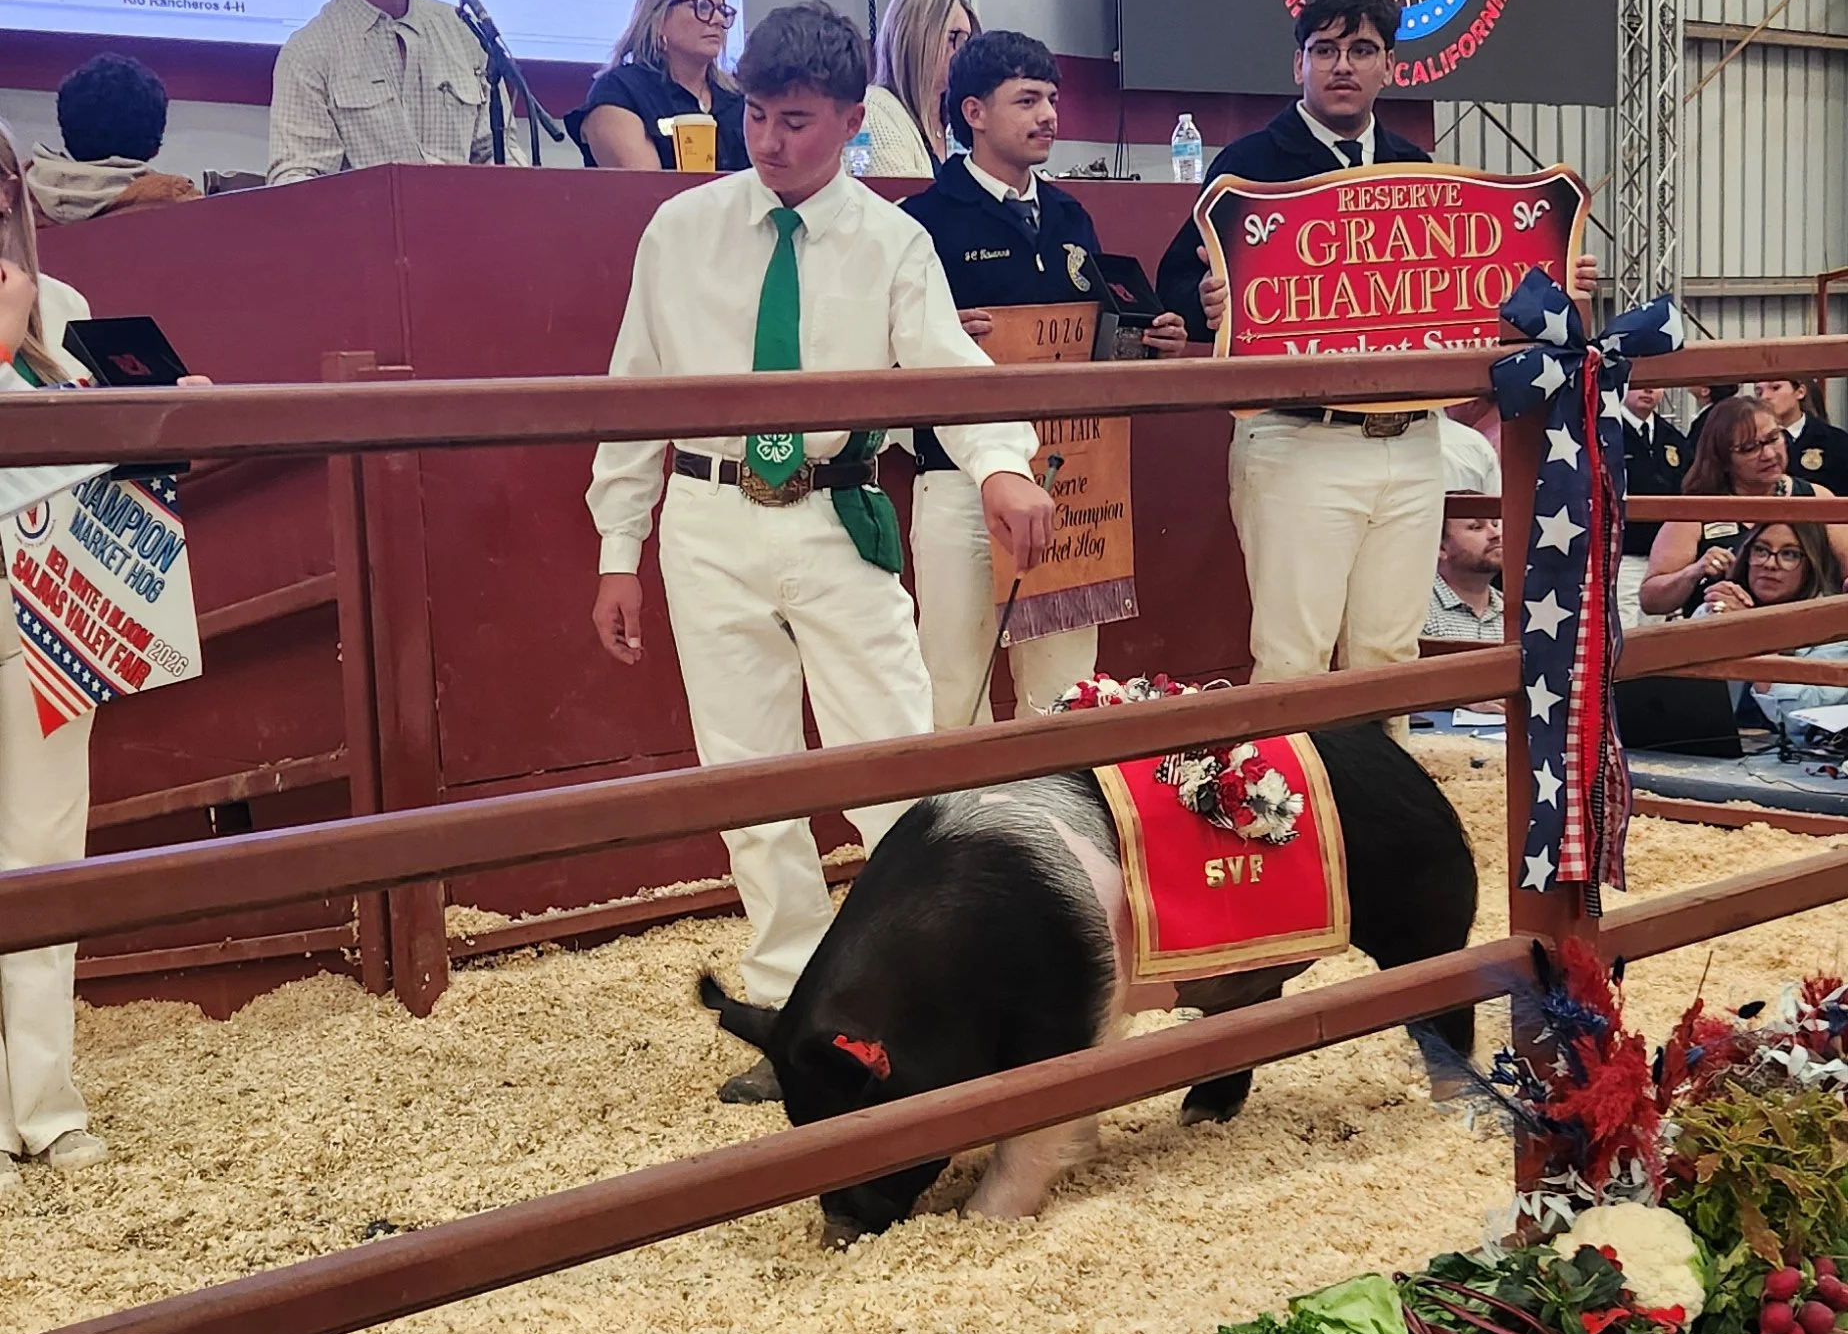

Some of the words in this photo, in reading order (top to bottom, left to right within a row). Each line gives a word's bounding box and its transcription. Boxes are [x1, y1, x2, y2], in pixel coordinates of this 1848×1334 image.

[223, 0, 245, 13] 4-H
[1336, 183, 1463, 213] RESERVE
[1296, 213, 1502, 268] GRAND
[1036, 317, 1084, 346] 2026
[71, 476, 187, 575] HAMPION
[1052, 499, 1124, 531] Champion
[68, 507, 132, 576] MARKET
[124, 559, 166, 604] HOG
[1041, 536, 1071, 563] rket
[1075, 530, 1105, 561] Hog
[11, 548, 69, 618] SALINAS
[64, 597, 115, 661] VALLEY
[107, 646, 152, 691] FAIR
[65, 566, 103, 613] WHITE
[149, 639, 189, 678] 2026
[1205, 854, 1264, 888] SVF
